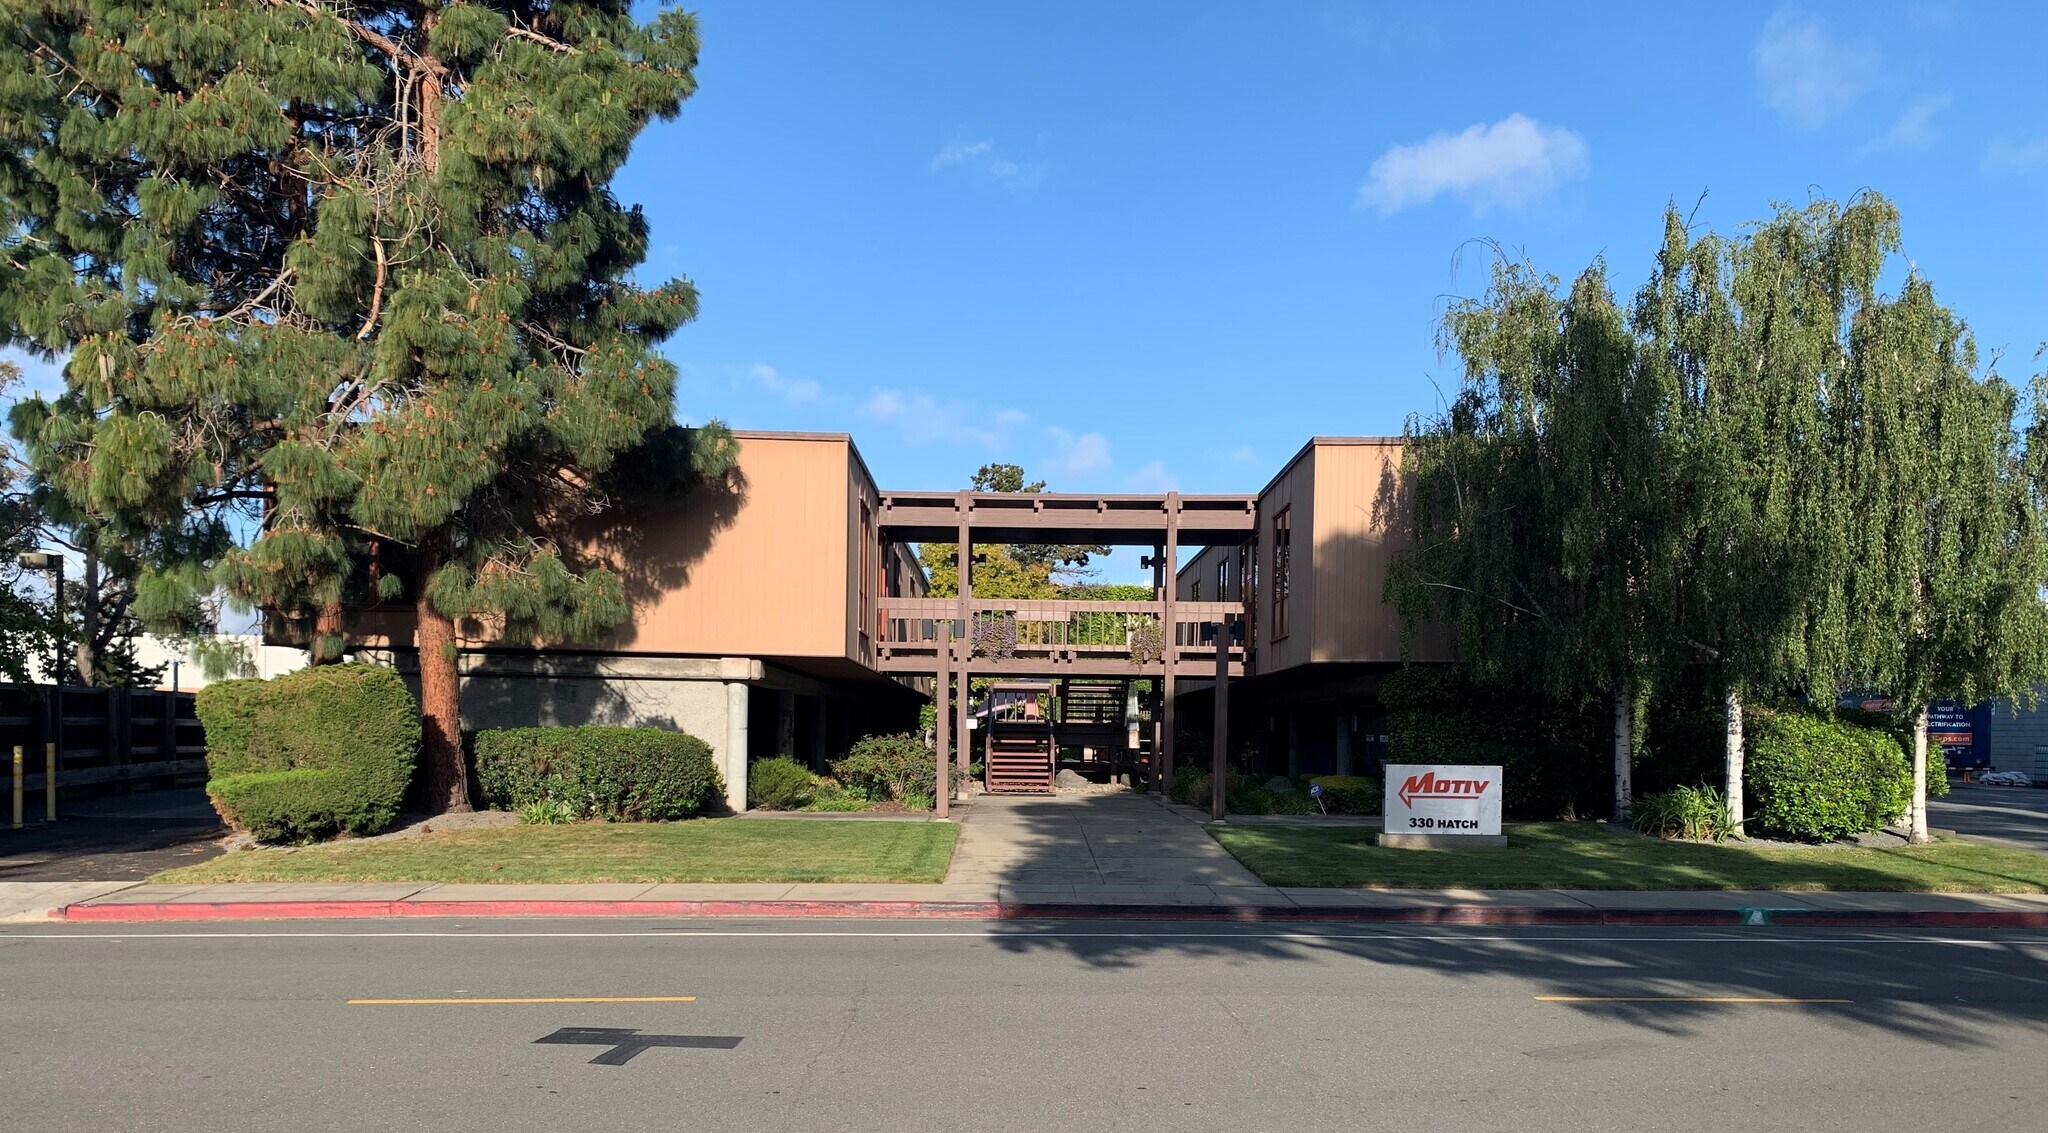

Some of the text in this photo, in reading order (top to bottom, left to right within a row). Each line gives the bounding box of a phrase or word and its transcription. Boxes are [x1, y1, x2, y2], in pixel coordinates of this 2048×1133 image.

[1398, 771, 1490, 794] MOTIV
[1409, 818, 1479, 829] 330 HATCH
